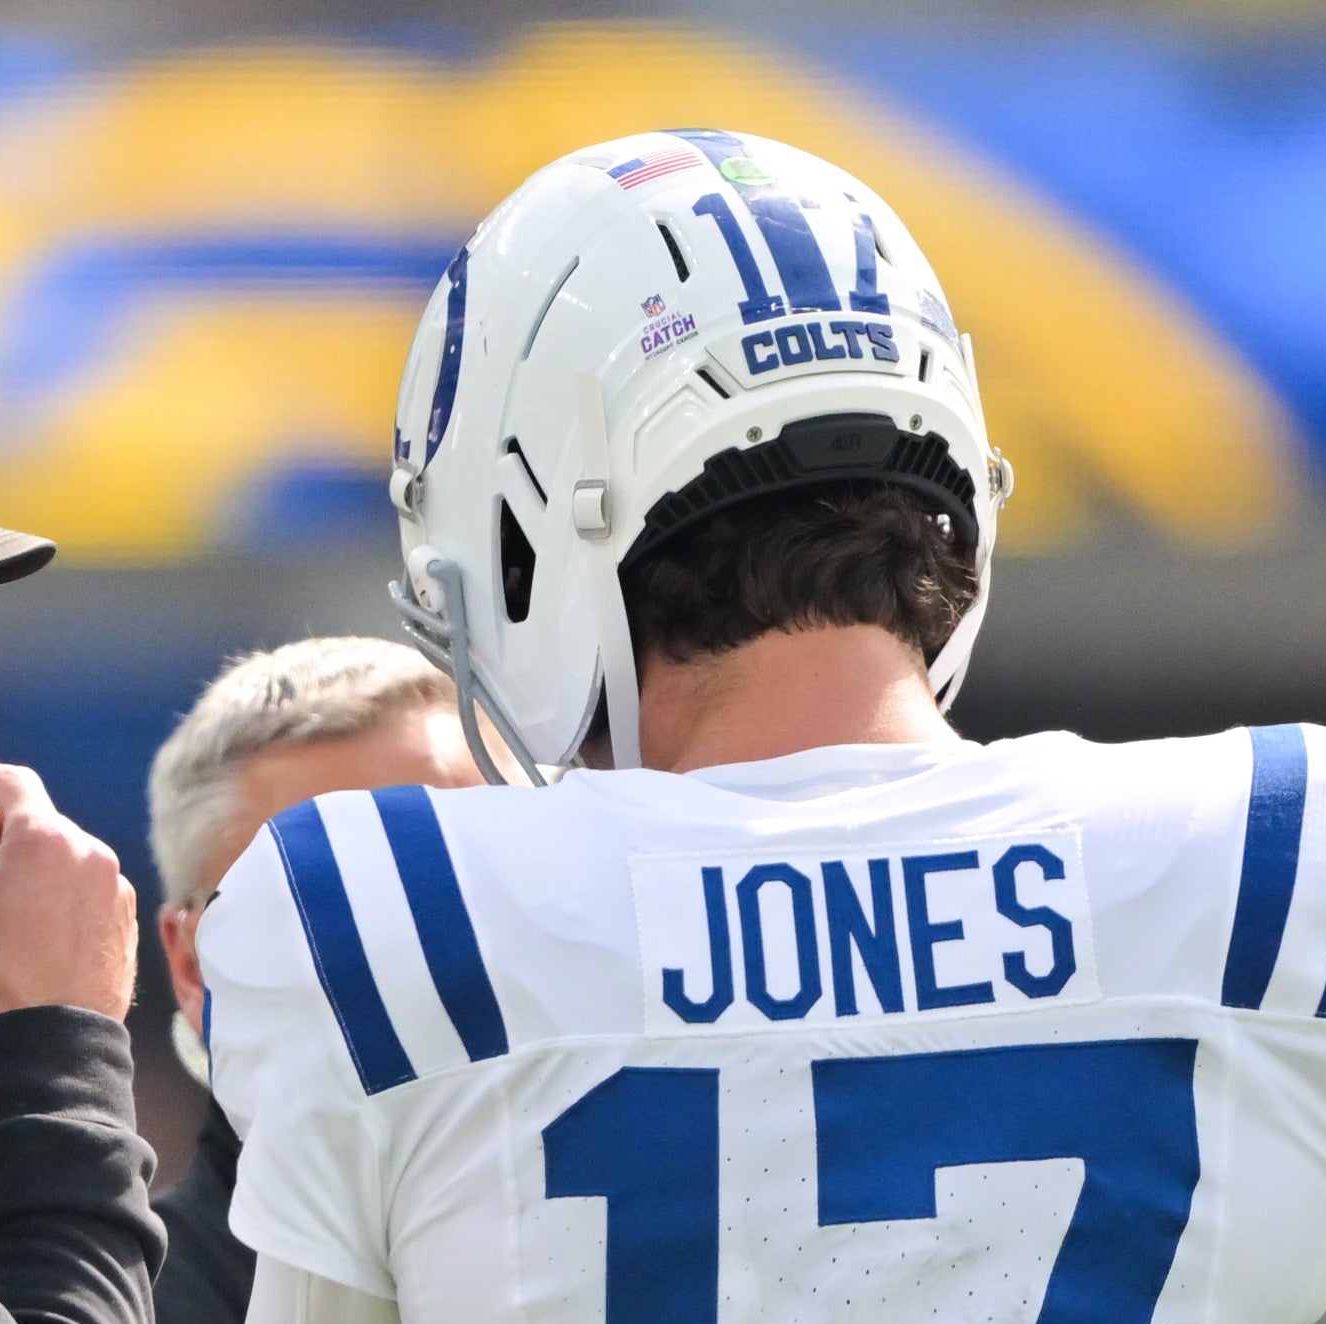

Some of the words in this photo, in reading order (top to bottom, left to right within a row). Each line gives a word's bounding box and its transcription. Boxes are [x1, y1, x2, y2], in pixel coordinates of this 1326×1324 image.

[640, 313, 696, 354] CATCH
[643, 310, 682, 334] CRUCIAL
[741, 320, 900, 375] COLTS
[662, 842, 1079, 1024] JONES
